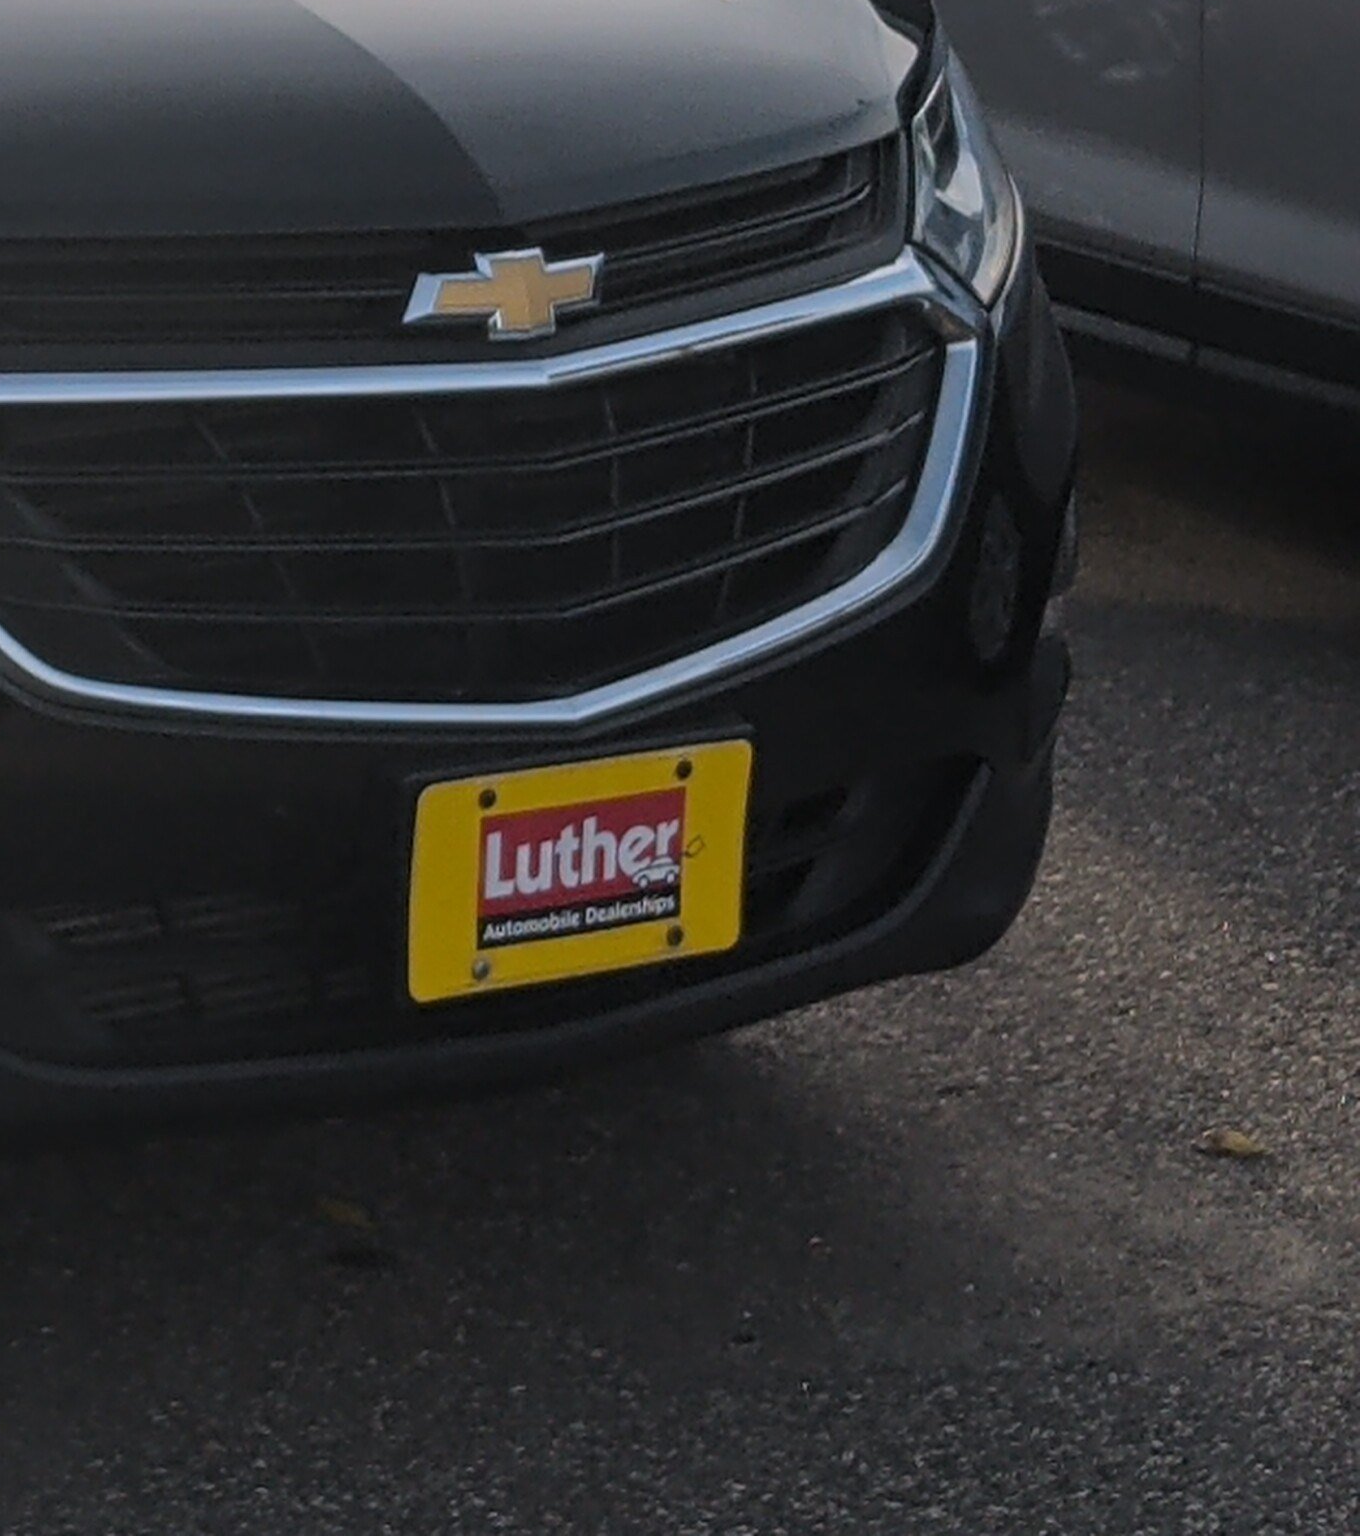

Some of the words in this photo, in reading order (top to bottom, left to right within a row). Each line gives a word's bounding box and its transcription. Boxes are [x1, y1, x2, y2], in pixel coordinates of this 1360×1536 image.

[484, 816, 680, 900] Luther
[483, 910, 580, 940] Automobile
[585, 893, 676, 924] Dealerships
